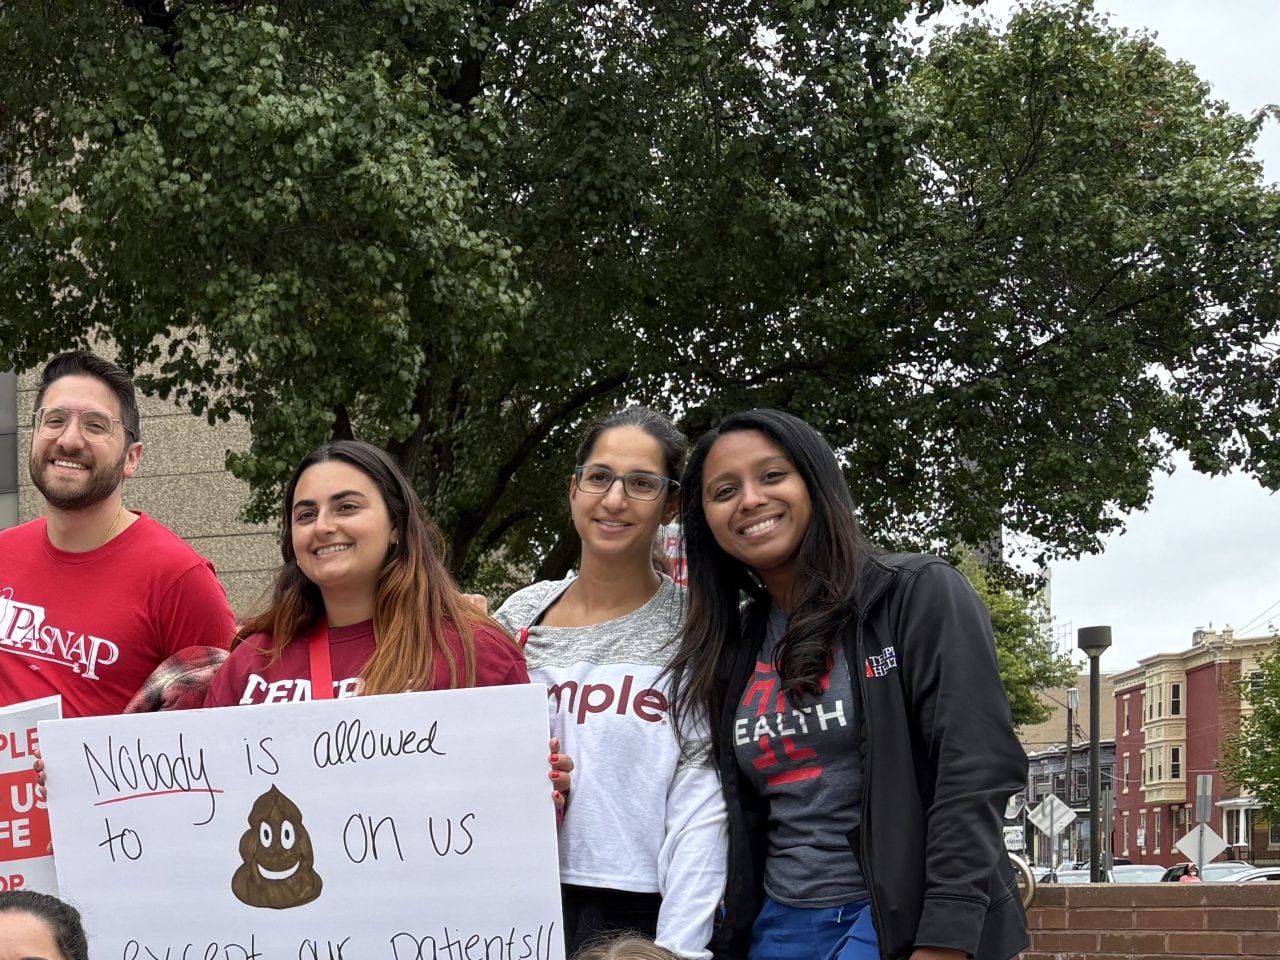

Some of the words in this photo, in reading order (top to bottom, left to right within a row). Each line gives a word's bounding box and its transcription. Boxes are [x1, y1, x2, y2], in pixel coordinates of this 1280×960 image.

[0, 605, 119, 680] PASNAP
[547, 674, 669, 725] mple
[734, 700, 848, 746] EALTH
[83, 733, 216, 826] Nobody
[243, 737, 279, 776] is
[313, 718, 447, 769] allowed
[98, 818, 143, 862] to
[343, 812, 404, 864] on
[428, 812, 475, 857] us
